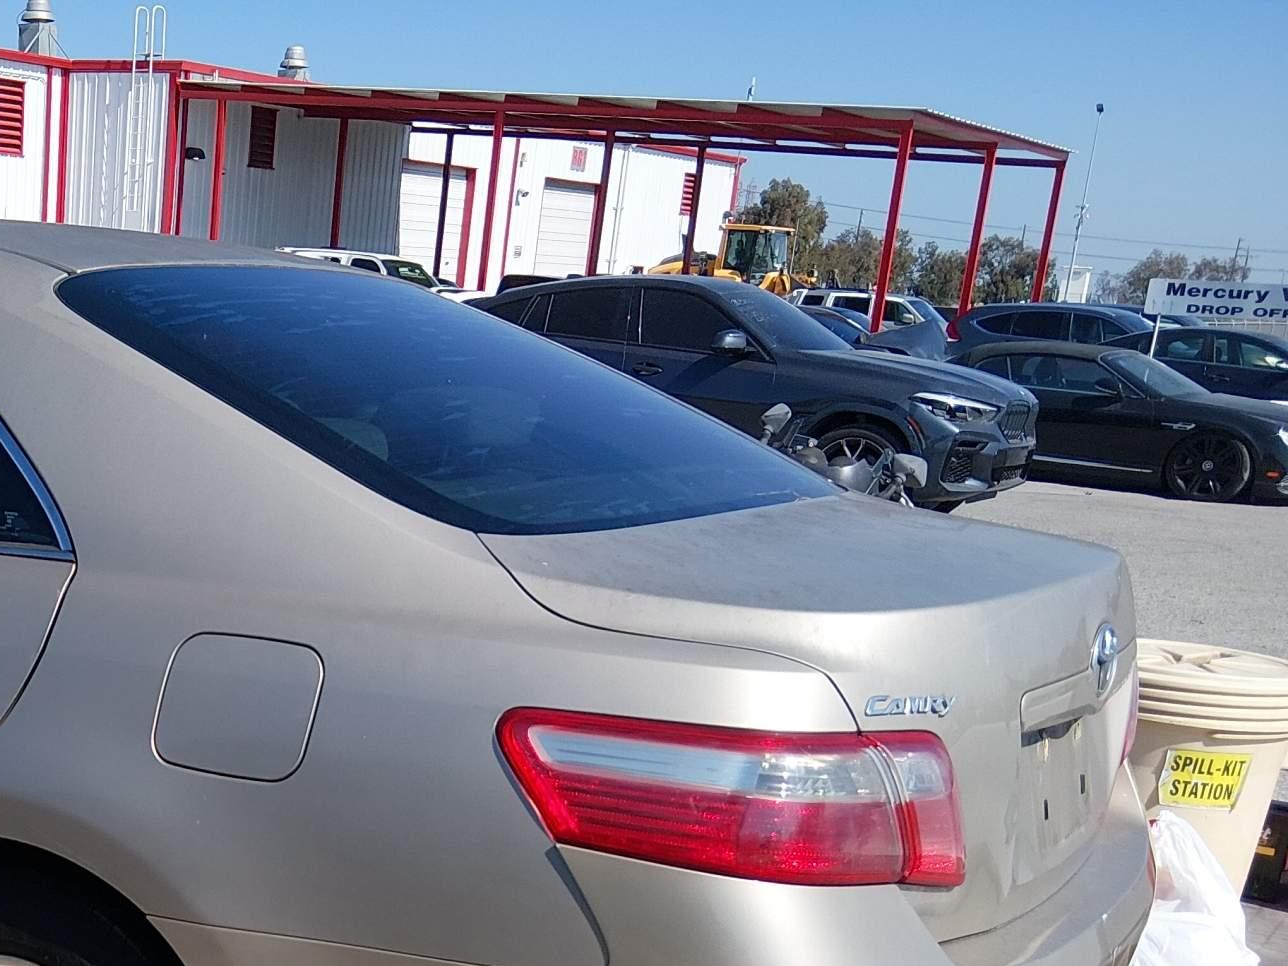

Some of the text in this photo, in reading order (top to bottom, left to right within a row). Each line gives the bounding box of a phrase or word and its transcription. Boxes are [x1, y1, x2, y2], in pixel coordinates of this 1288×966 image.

[1165, 282, 1270, 304] Mercury
[1185, 303, 1244, 316] DROP
[864, 695, 955, 718] Camry
[1170, 754, 1246, 777] SPILL-KIT
[1169, 779, 1235, 801] STATION
